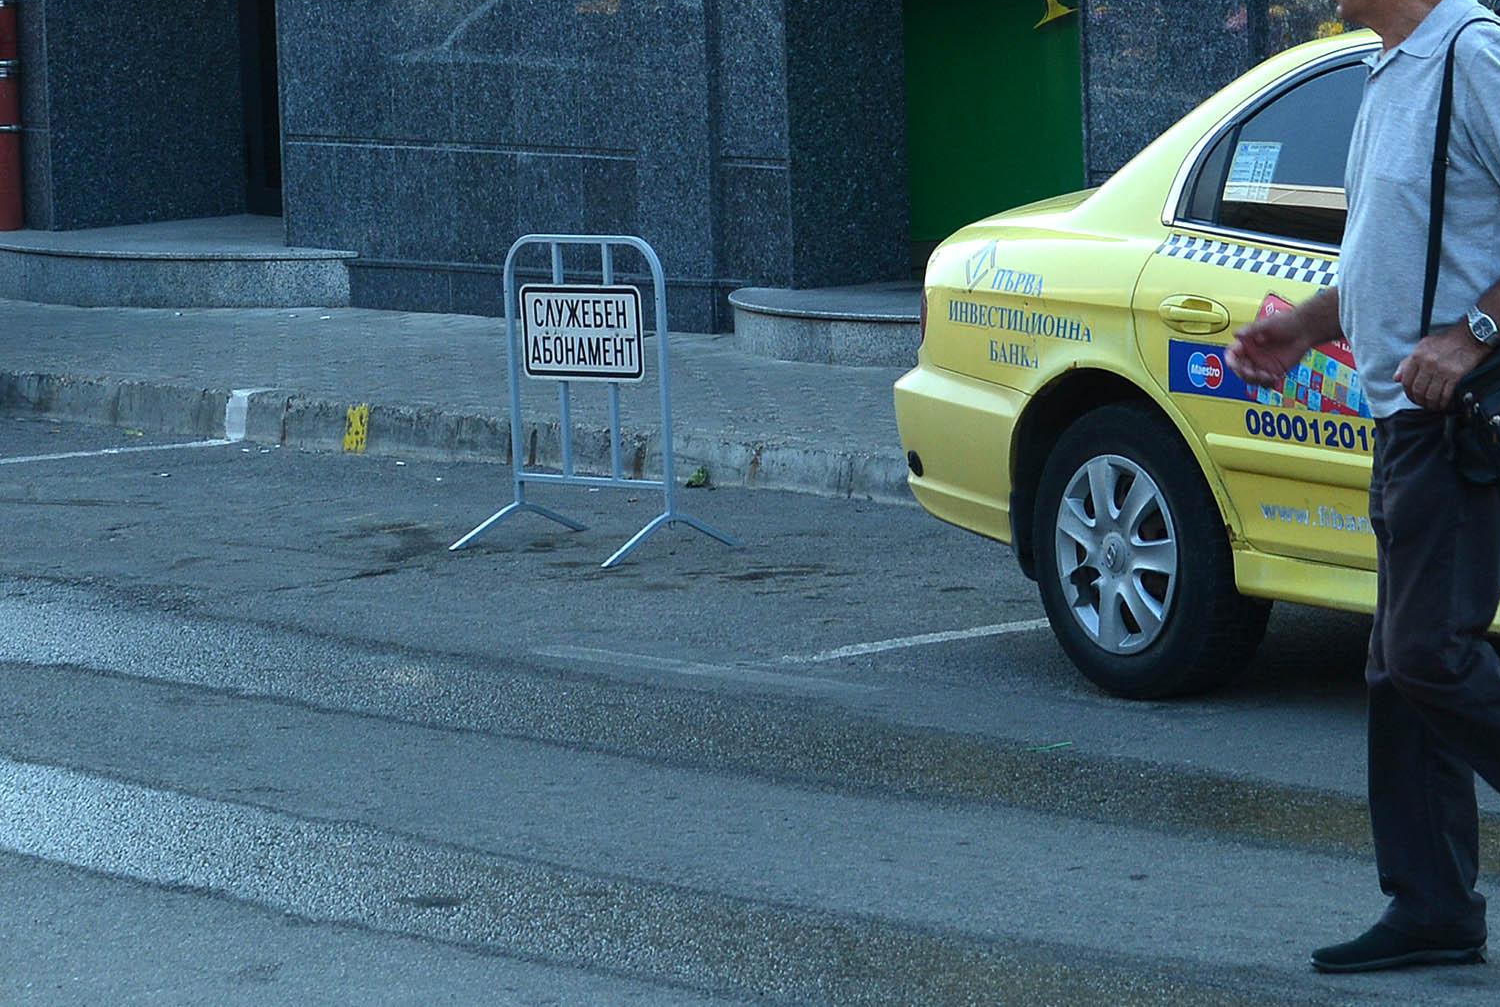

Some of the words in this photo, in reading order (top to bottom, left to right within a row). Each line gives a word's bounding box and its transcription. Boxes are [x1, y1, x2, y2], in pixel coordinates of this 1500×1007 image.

[991, 268, 1044, 298] ПЪРВА
[533, 298, 627, 329] СЛУЖЕБЕН
[949, 299, 1092, 343] ИНВЕСТИЦИОННА
[531, 335, 635, 366] АБОНАМЕНТ
[990, 340, 1039, 369] БАНКА
[1191, 364, 1220, 377] Maestro
[1245, 408, 1376, 451] 08001201
[1259, 503, 1375, 535] www.fiban
